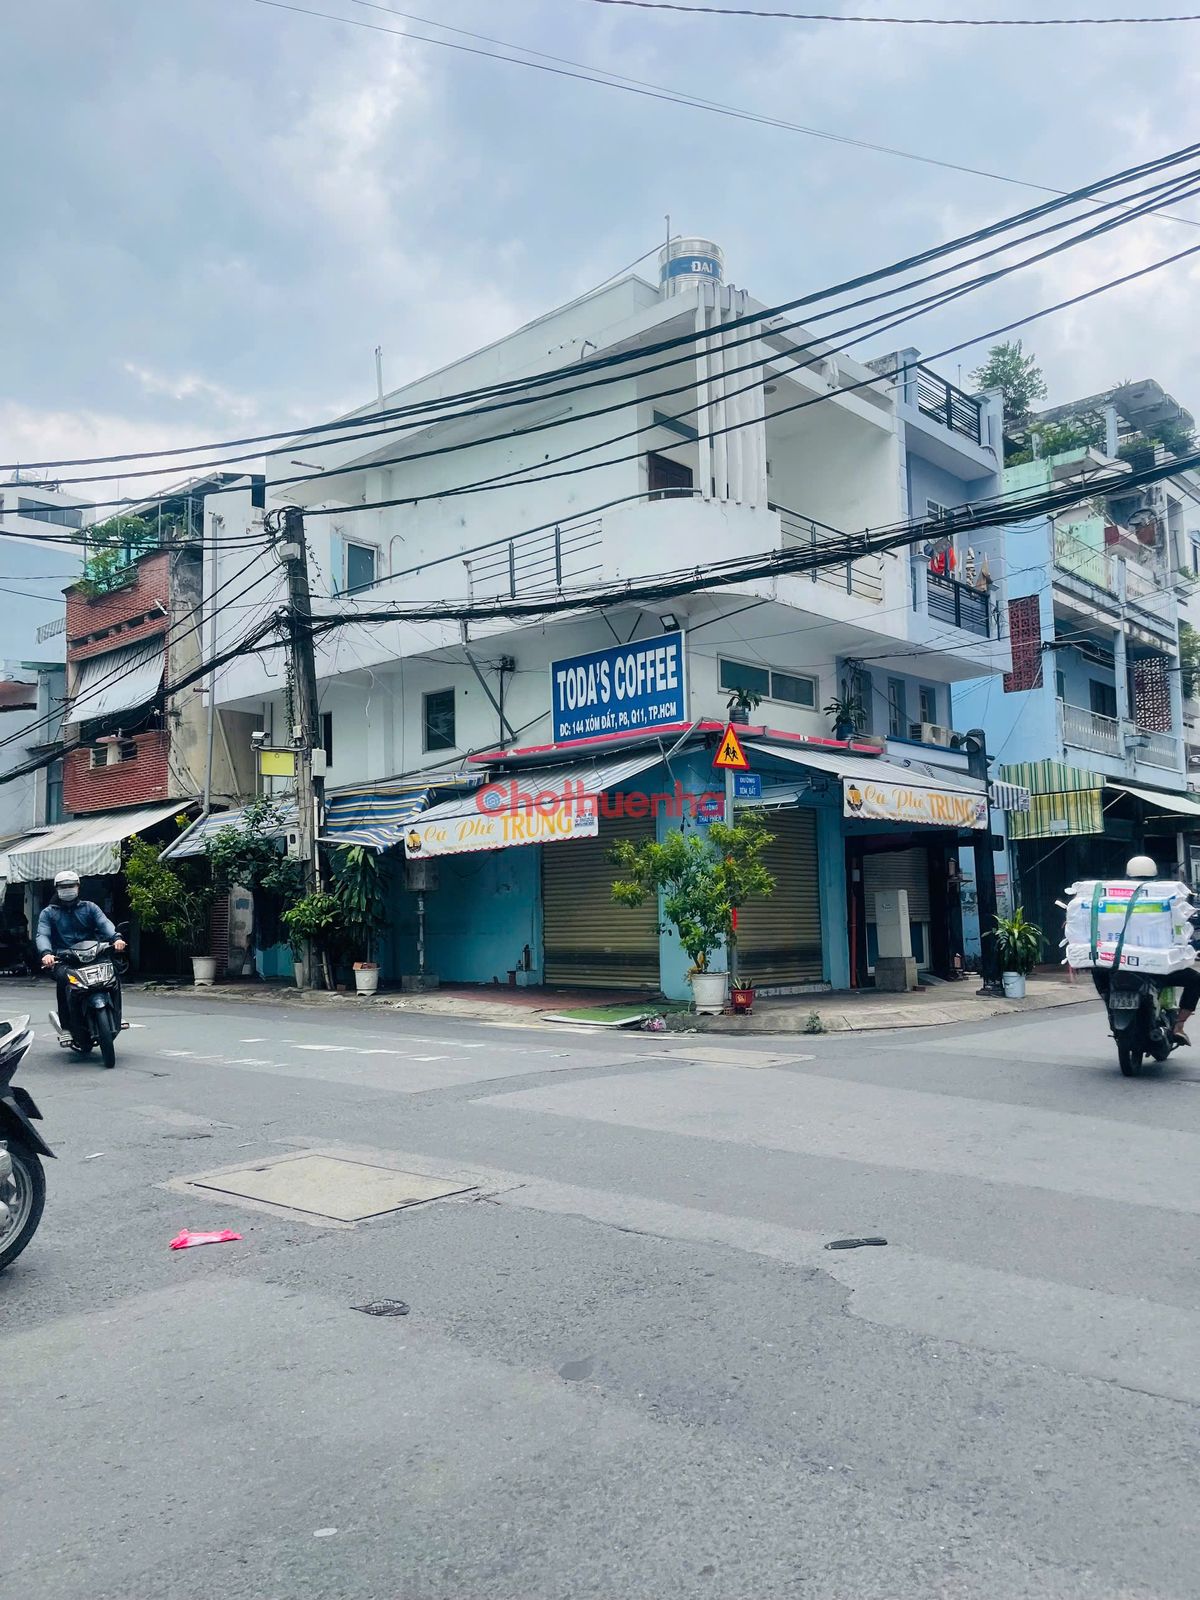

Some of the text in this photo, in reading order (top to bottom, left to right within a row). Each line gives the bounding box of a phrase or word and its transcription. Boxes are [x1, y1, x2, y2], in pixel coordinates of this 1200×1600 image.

[557, 644, 678, 711] TODA'S COFFEE
[572, 721, 584, 735] 144
[585, 714, 600, 732] XÓM
[619, 711, 630, 728] P8,
[631, 708, 647, 725] Q11,
[648, 701, 677, 721] TP.HCM
